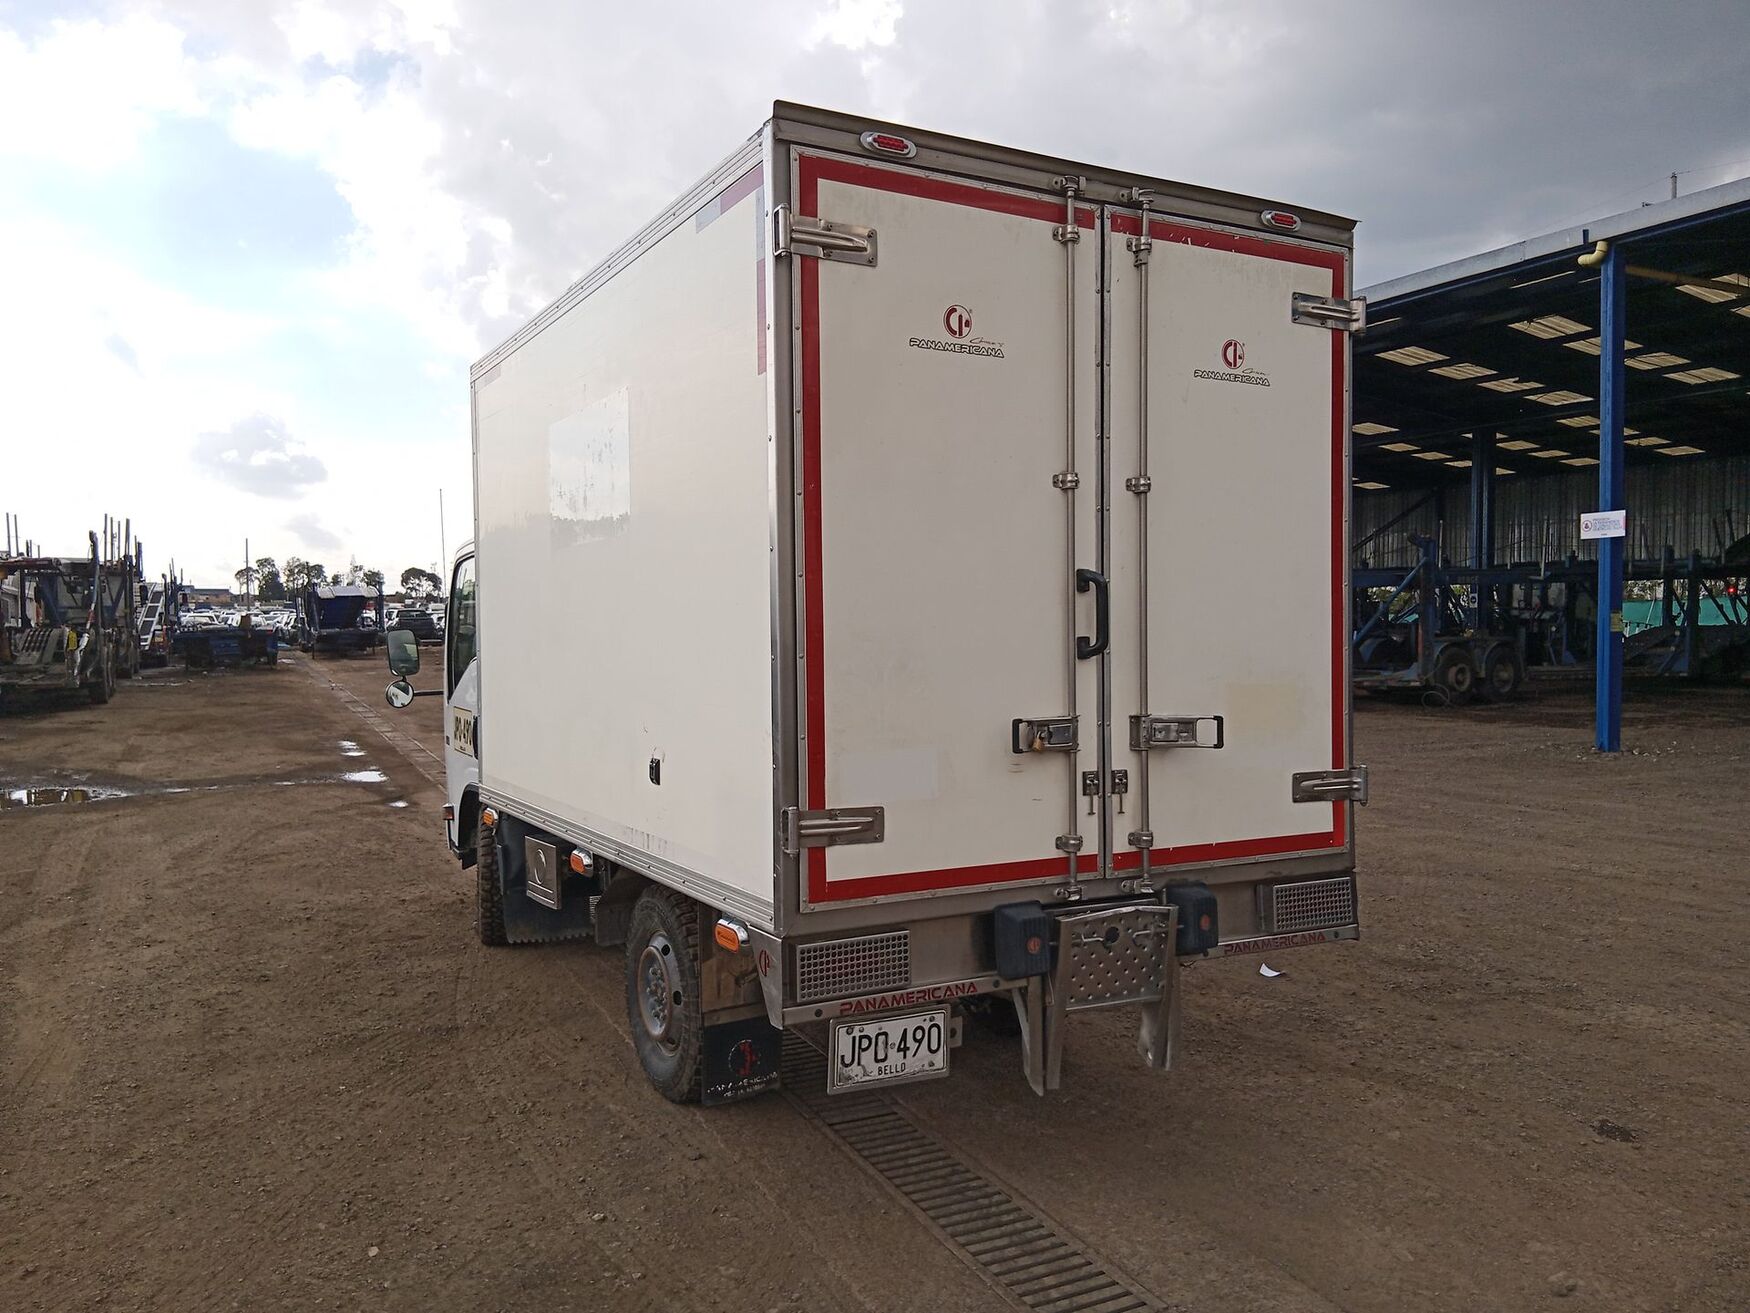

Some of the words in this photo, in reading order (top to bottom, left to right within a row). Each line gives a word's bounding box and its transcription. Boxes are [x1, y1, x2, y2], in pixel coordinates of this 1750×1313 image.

[909, 337, 1004, 358] PANAMERICANA
[1194, 369, 1270, 387] PANAMERICANA
[1223, 930, 1326, 955] PANAMERICANA
[839, 981, 979, 1016] PANAMERICANA
[877, 1062, 906, 1076] BELLO
